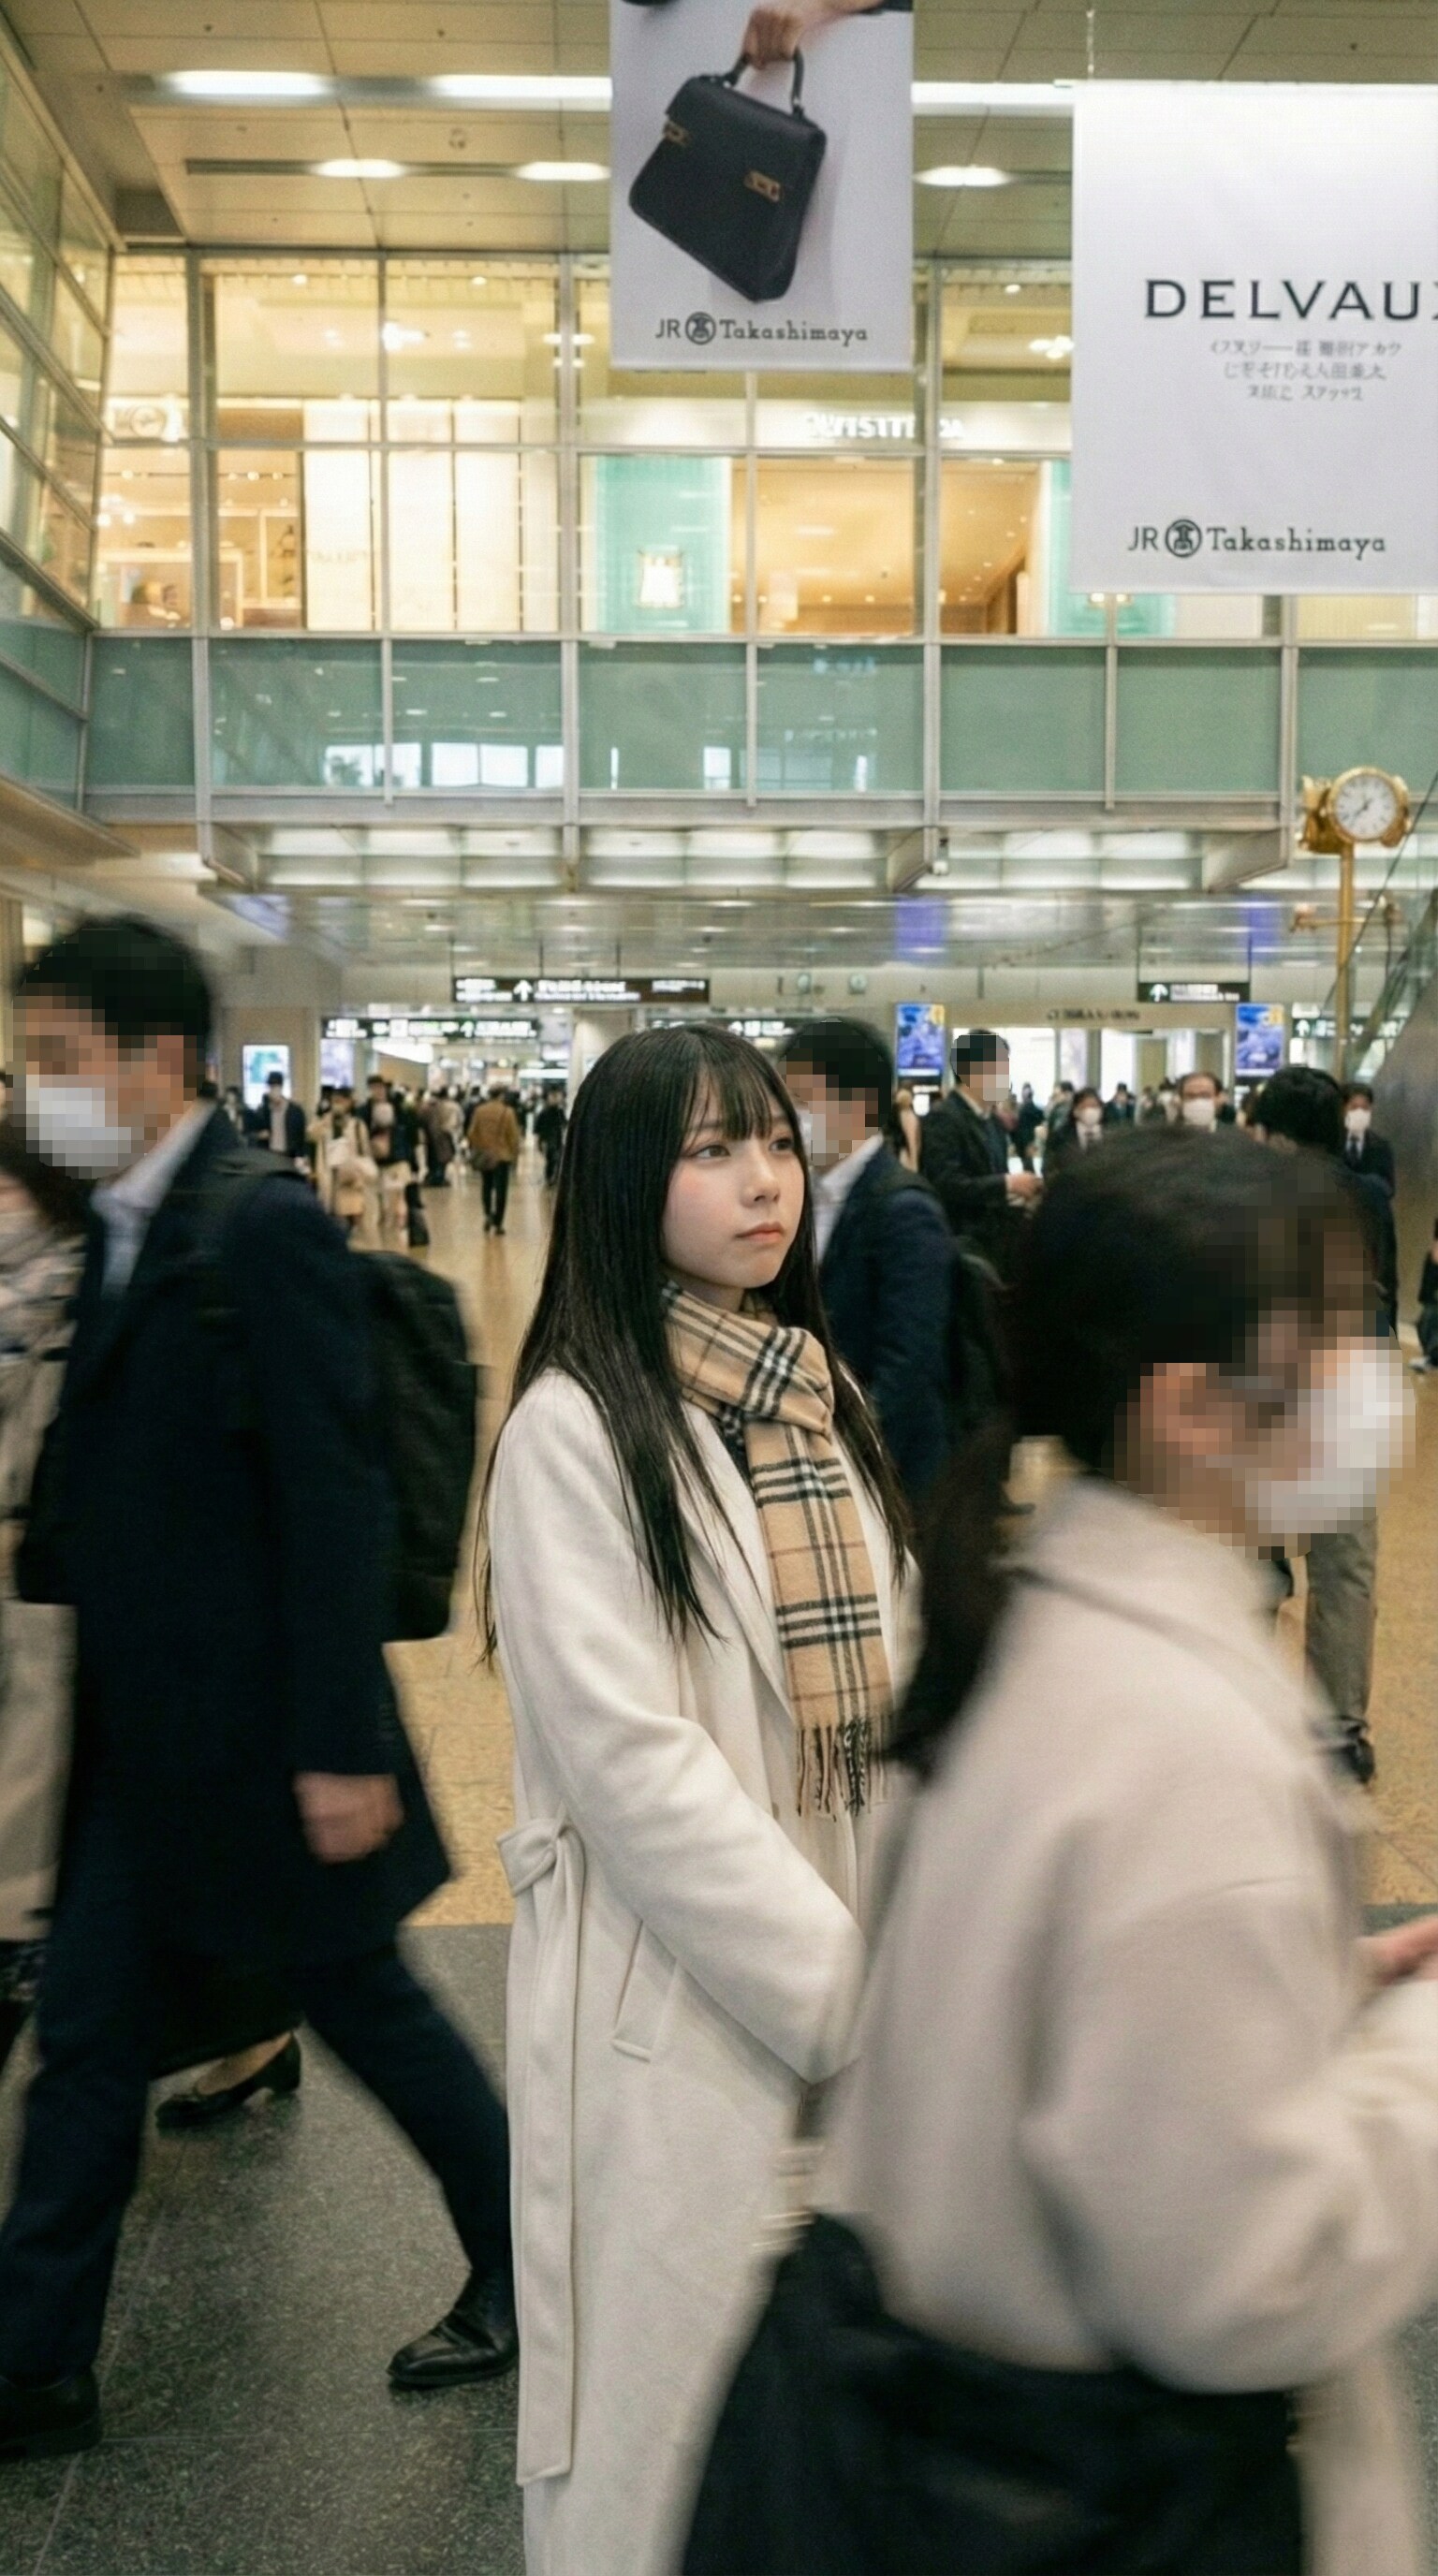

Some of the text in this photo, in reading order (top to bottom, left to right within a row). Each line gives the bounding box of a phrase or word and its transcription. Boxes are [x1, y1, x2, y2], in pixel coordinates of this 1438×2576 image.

[655, 318, 681, 339] JR
[719, 318, 868, 347] Takashimaya
[1128, 526, 1158, 551] JR
[1206, 526, 1386, 561] Takashimaya
